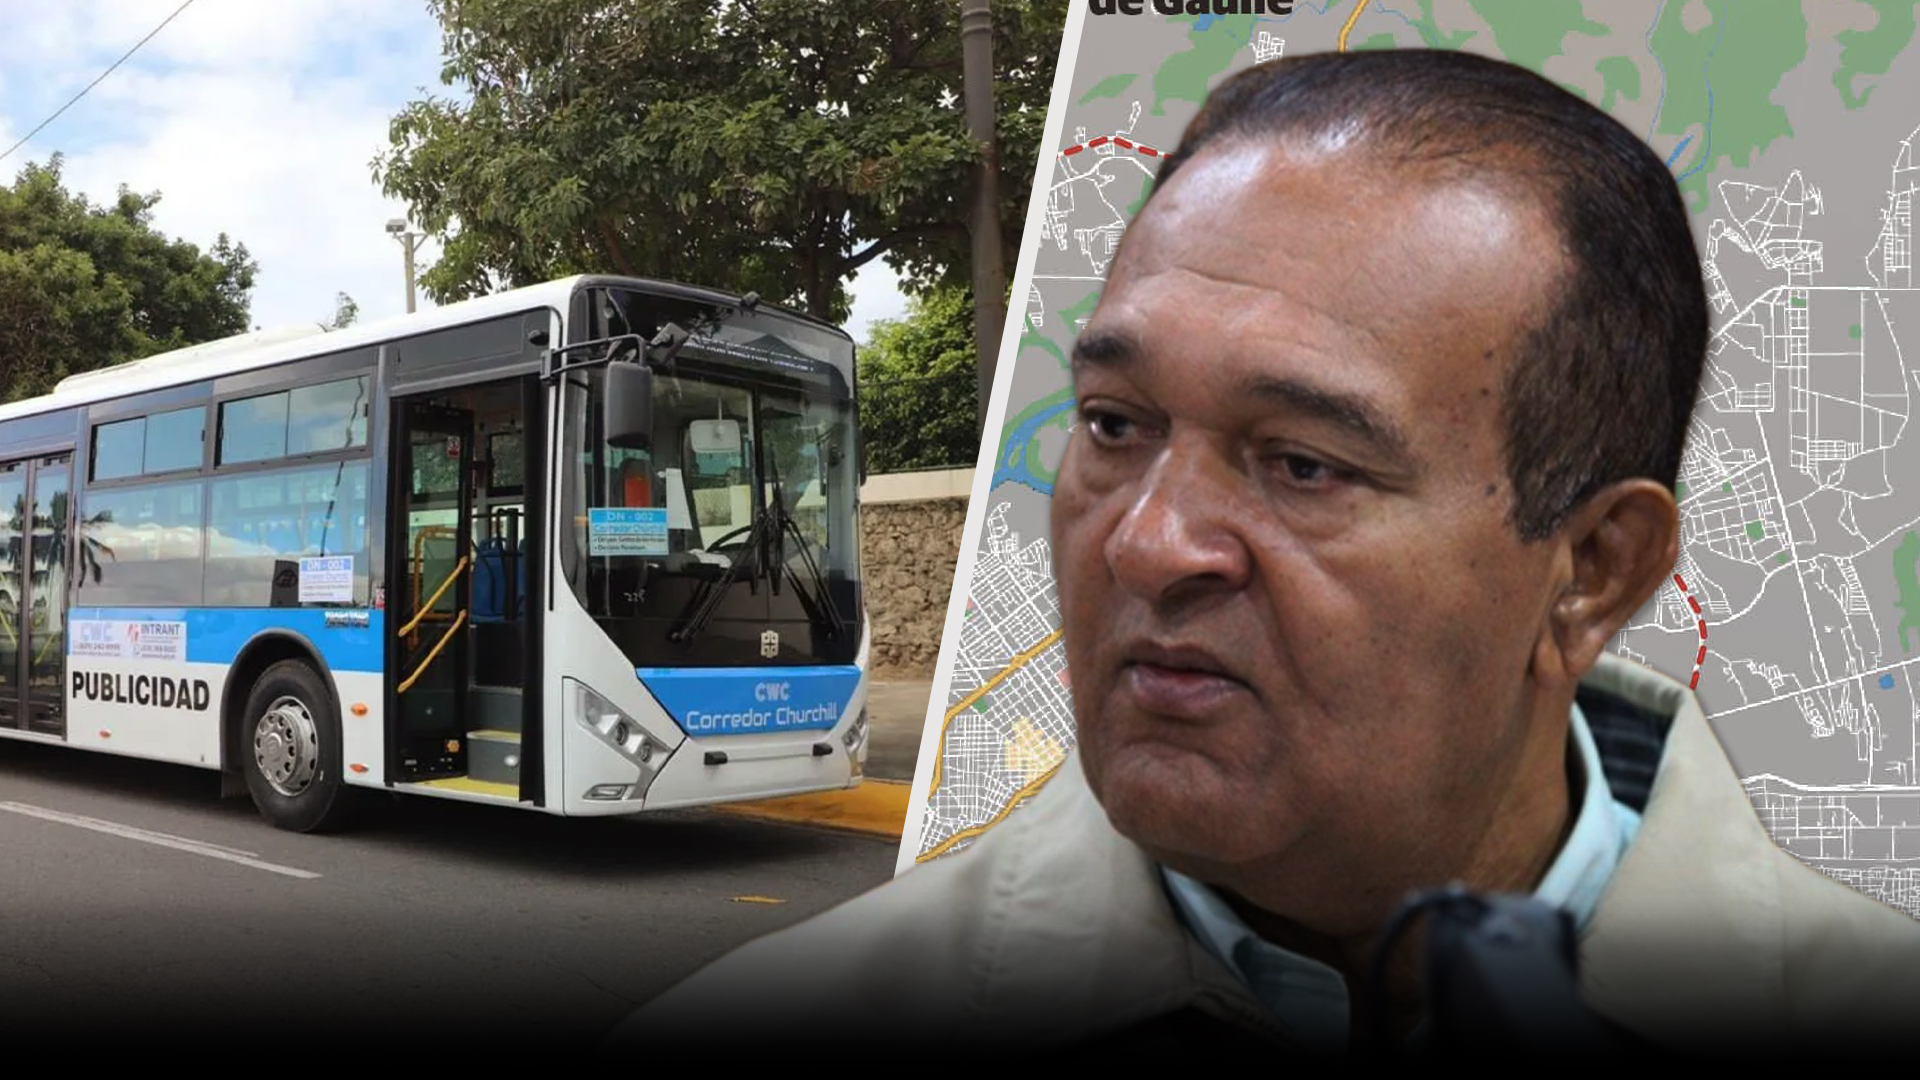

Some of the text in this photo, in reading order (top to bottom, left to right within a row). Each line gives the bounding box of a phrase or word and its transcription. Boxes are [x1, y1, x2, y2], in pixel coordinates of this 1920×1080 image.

[141, 623, 181, 636] INTRANT
[72, 671, 210, 711] PUBLICIDAD
[755, 682, 790, 701] CWC
[686, 703, 837, 730] Corredor Churchill
